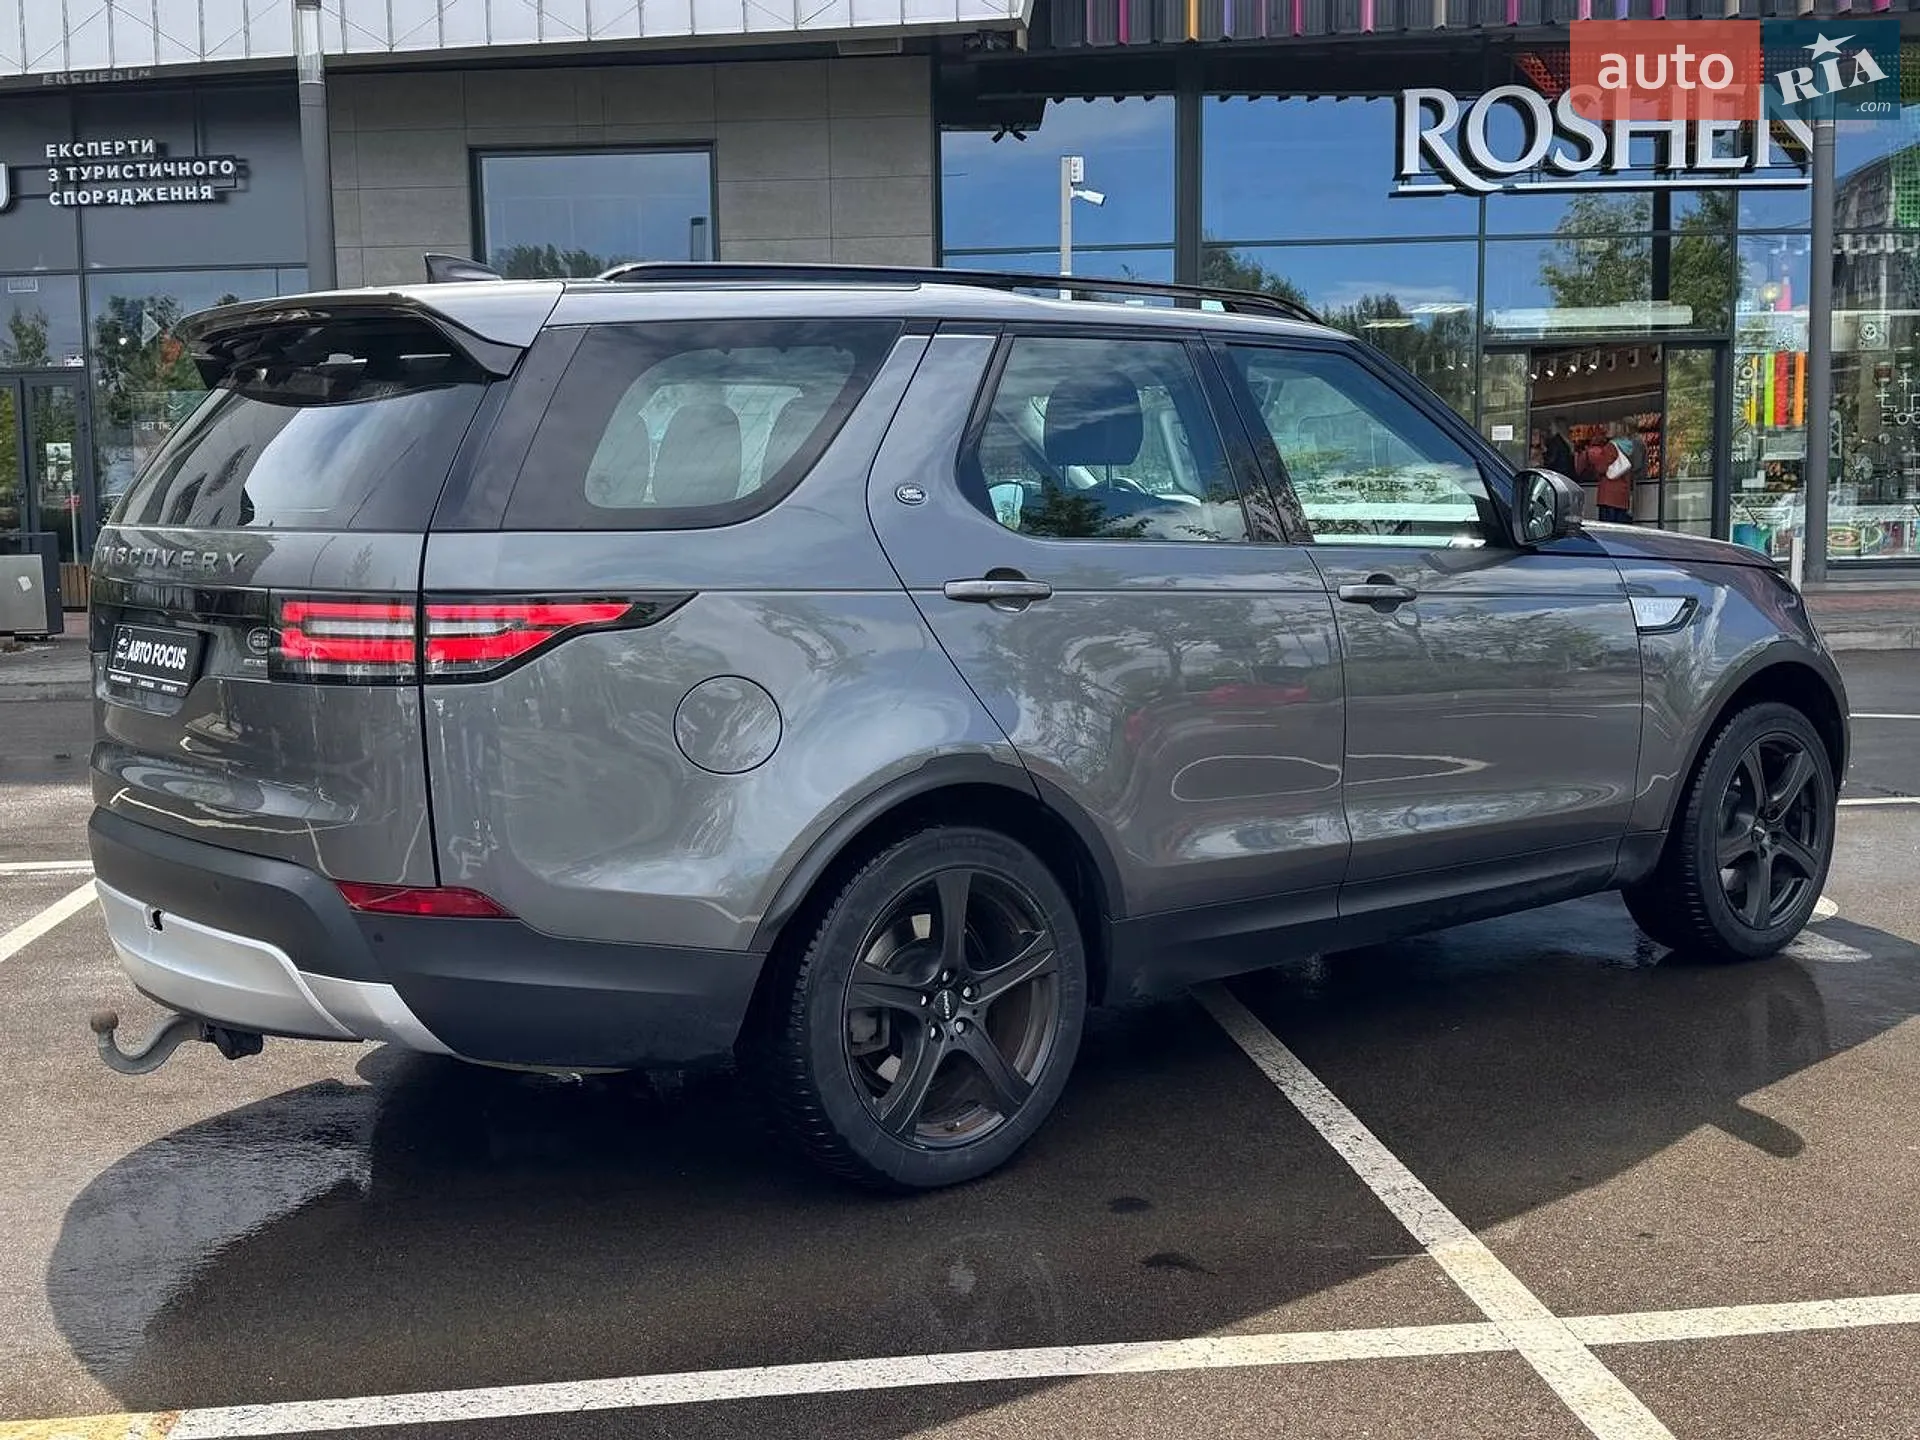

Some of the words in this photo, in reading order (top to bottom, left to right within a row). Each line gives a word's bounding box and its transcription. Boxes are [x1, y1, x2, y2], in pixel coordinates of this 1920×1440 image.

[46, 139, 155, 158] ЕКСПЕРТИ
[66, 160, 235, 182] ТУРИСТИЧНОГО
[49, 184, 215, 206] СПОРЯДЖЕННЯ
[99, 545, 245, 574] DISCOVERY
[151, 643, 188, 670] FOCUS
